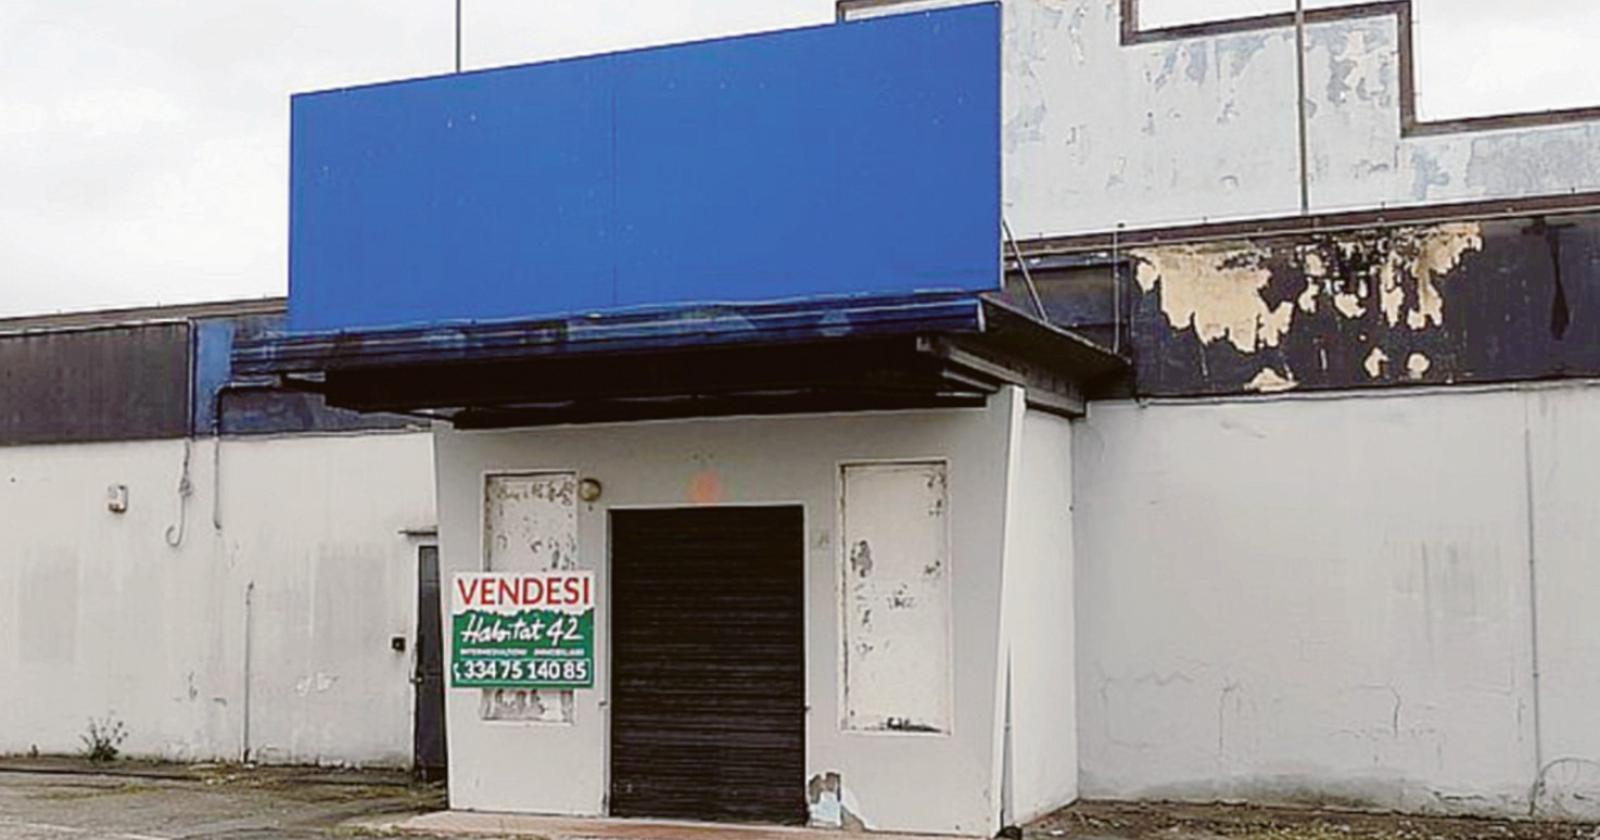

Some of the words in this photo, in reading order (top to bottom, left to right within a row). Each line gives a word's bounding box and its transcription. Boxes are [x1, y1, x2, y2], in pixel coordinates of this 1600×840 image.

[457, 576, 589, 605] VENDESI
[460, 613, 545, 644] Habitat
[546, 617, 584, 646] 42
[464, 660, 497, 679] 334
[501, 661, 523, 679] 75
[527, 661, 560, 679] 140
[563, 661, 587, 679] 85
